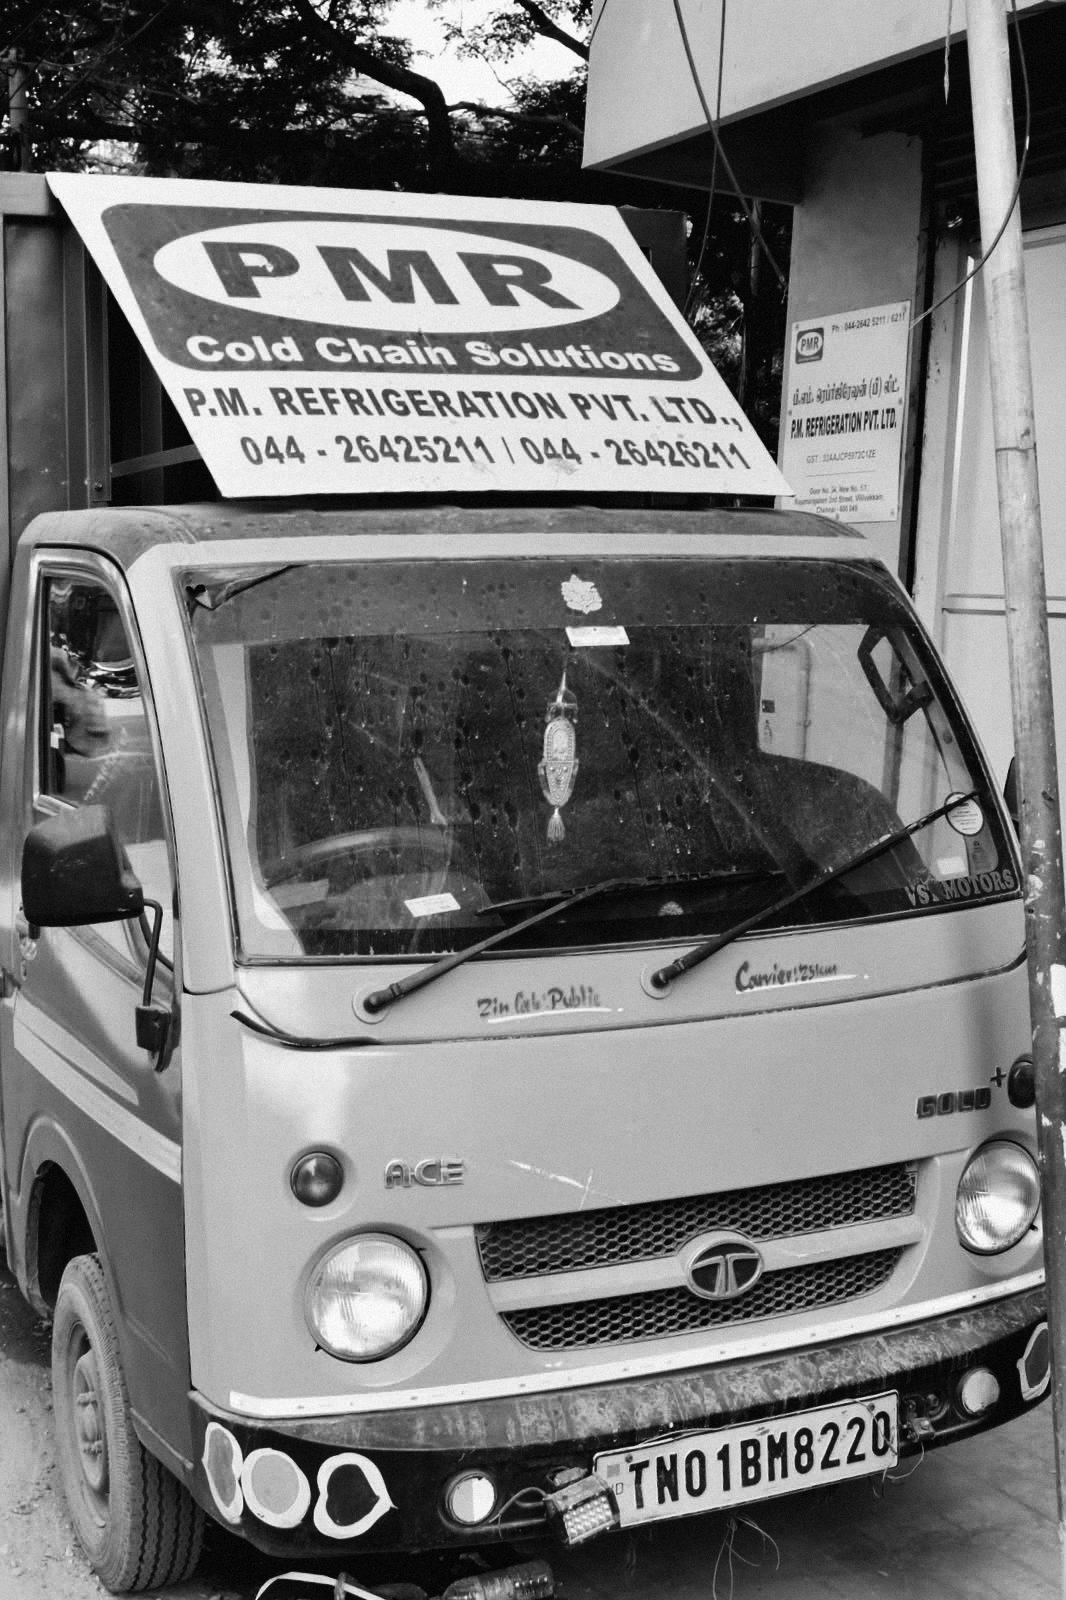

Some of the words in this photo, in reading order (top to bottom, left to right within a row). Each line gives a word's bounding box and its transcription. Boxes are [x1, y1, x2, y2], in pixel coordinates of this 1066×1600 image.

[201, 241, 584, 310] PMR
[186, 335, 303, 363] Cold
[315, 336, 457, 366] Chain
[465, 340, 681, 373] Solutions
[800, 335, 820, 353] PMR
[183, 387, 263, 417] P.M.
[269, 386, 568, 420] REFRIGERATION
[568, 392, 650, 422] PVT.
[805, 411, 863, 438] REFRIGERATION
[240, 436, 305, 465] 044
[335, 435, 495, 464] 26425211
[520, 436, 582, 465] 044
[605, 438, 752, 469] 26426211
[940, 869, 1015, 900] MOTORS
[383, 1159, 464, 1190] ACE
